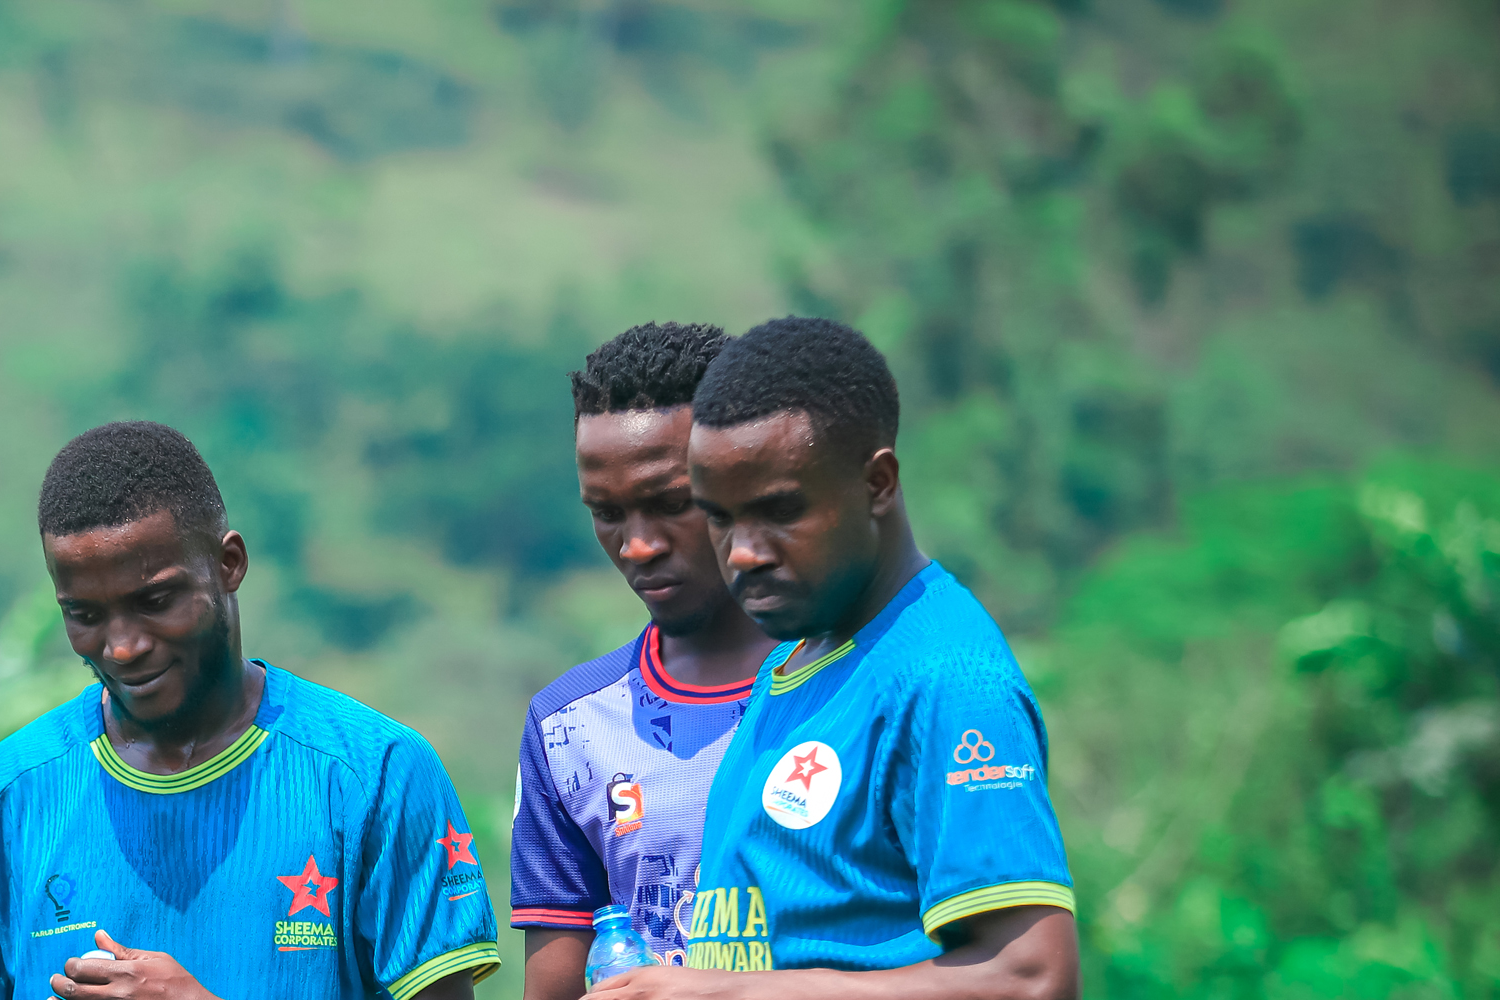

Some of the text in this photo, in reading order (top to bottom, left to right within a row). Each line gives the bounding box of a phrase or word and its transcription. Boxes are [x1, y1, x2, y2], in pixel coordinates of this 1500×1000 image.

[770, 785, 807, 808] SHEEMA
[441, 870, 484, 888] SHEEMA
[54, 921, 97, 935] ELECTRONICS
[275, 921, 335, 936] SHEEMA
[274, 935, 338, 946] CORPORATES
